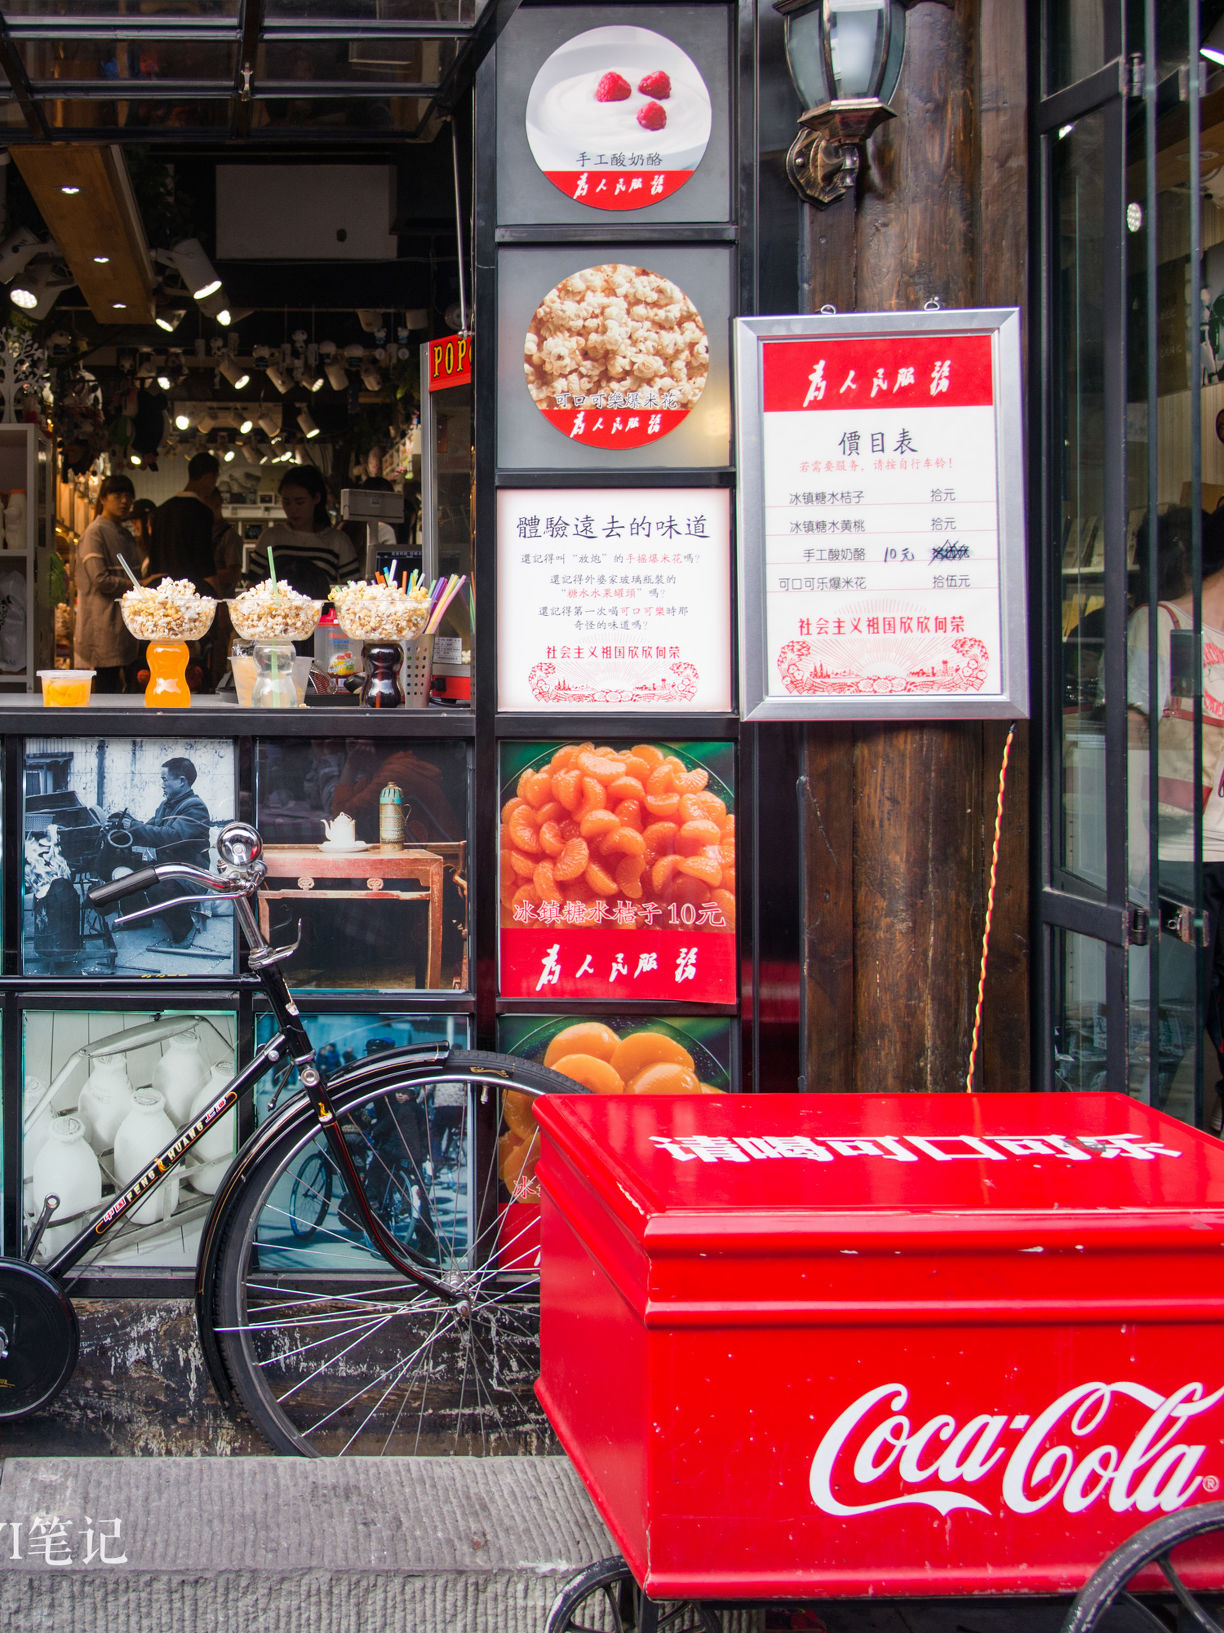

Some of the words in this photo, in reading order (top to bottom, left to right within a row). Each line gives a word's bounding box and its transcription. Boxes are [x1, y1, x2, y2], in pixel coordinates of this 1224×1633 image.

[575, 151, 664, 168] 手工酸奶酪
[432, 338, 472, 378] POP
[555, 391, 680, 409] 可口可樂爆米花
[837, 427, 919, 457] 價目表
[930, 488, 956, 502] 拾元
[516, 514, 711, 540] 體驗遠去的味道
[930, 517, 957, 531] 拾元
[802, 547, 867, 562] 手工酸奶酪
[883, 546, 915, 563] 10元
[778, 576, 867, 591] 可口可乐爆米花
[932, 574, 971, 589] 拾伍元
[798, 615, 966, 637] 社会主义祖国欣欣向荣
[546, 645, 681, 660] 社会主义祖国欣欣向荣
[648, 1133, 1183, 1163] 请喝可口可乐
[126, 1169, 157, 1202] FENG
[166, 1121, 205, 1161] HUANG
[512, 1175, 542, 1200] 冰
[809, 1381, 1224, 1517] Coca-Cola
